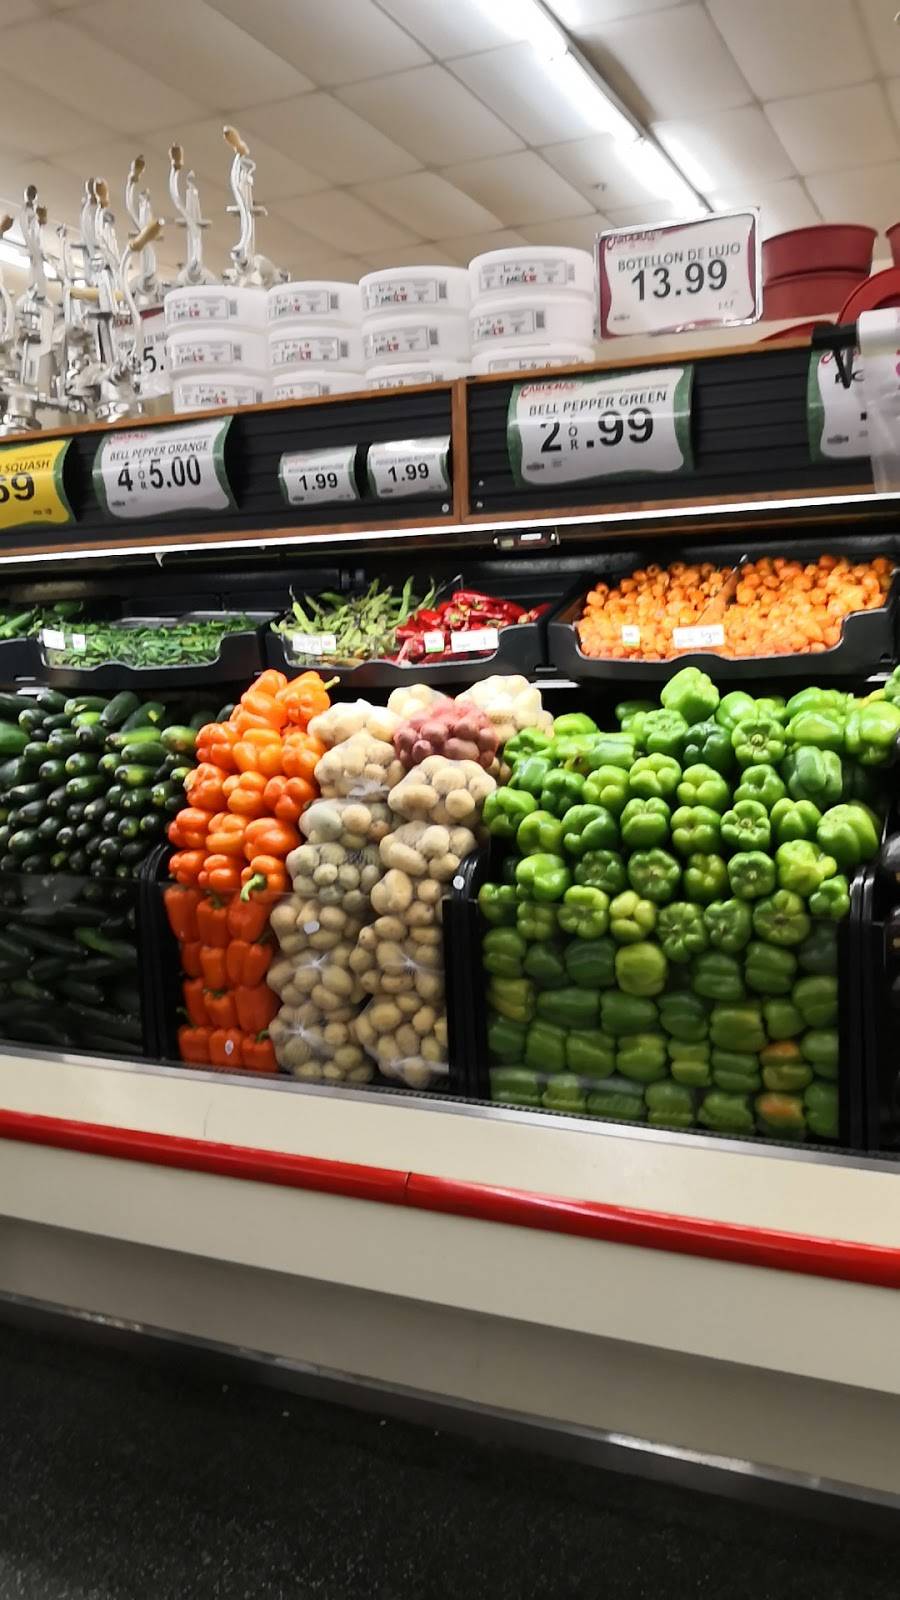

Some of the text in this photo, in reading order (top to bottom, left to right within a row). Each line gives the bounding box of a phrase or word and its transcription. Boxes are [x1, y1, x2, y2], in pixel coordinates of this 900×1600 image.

[617, 242, 741, 272] BOTELLON DE LUJO
[631, 259, 727, 301] 13.99
[529, 391, 667, 416] BELL PEPPER GREEN
[540, 416, 562, 453] 2
[586, 407, 654, 448] .99
[110, 440, 208, 461] BELL PEPPER ORANGE
[5, 460, 50, 473] SQUASH
[117, 462, 134, 492] 4
[149, 454, 201, 489] 5.00
[299, 472, 338, 491] 1.99
[387, 462, 430, 483] 1.99
